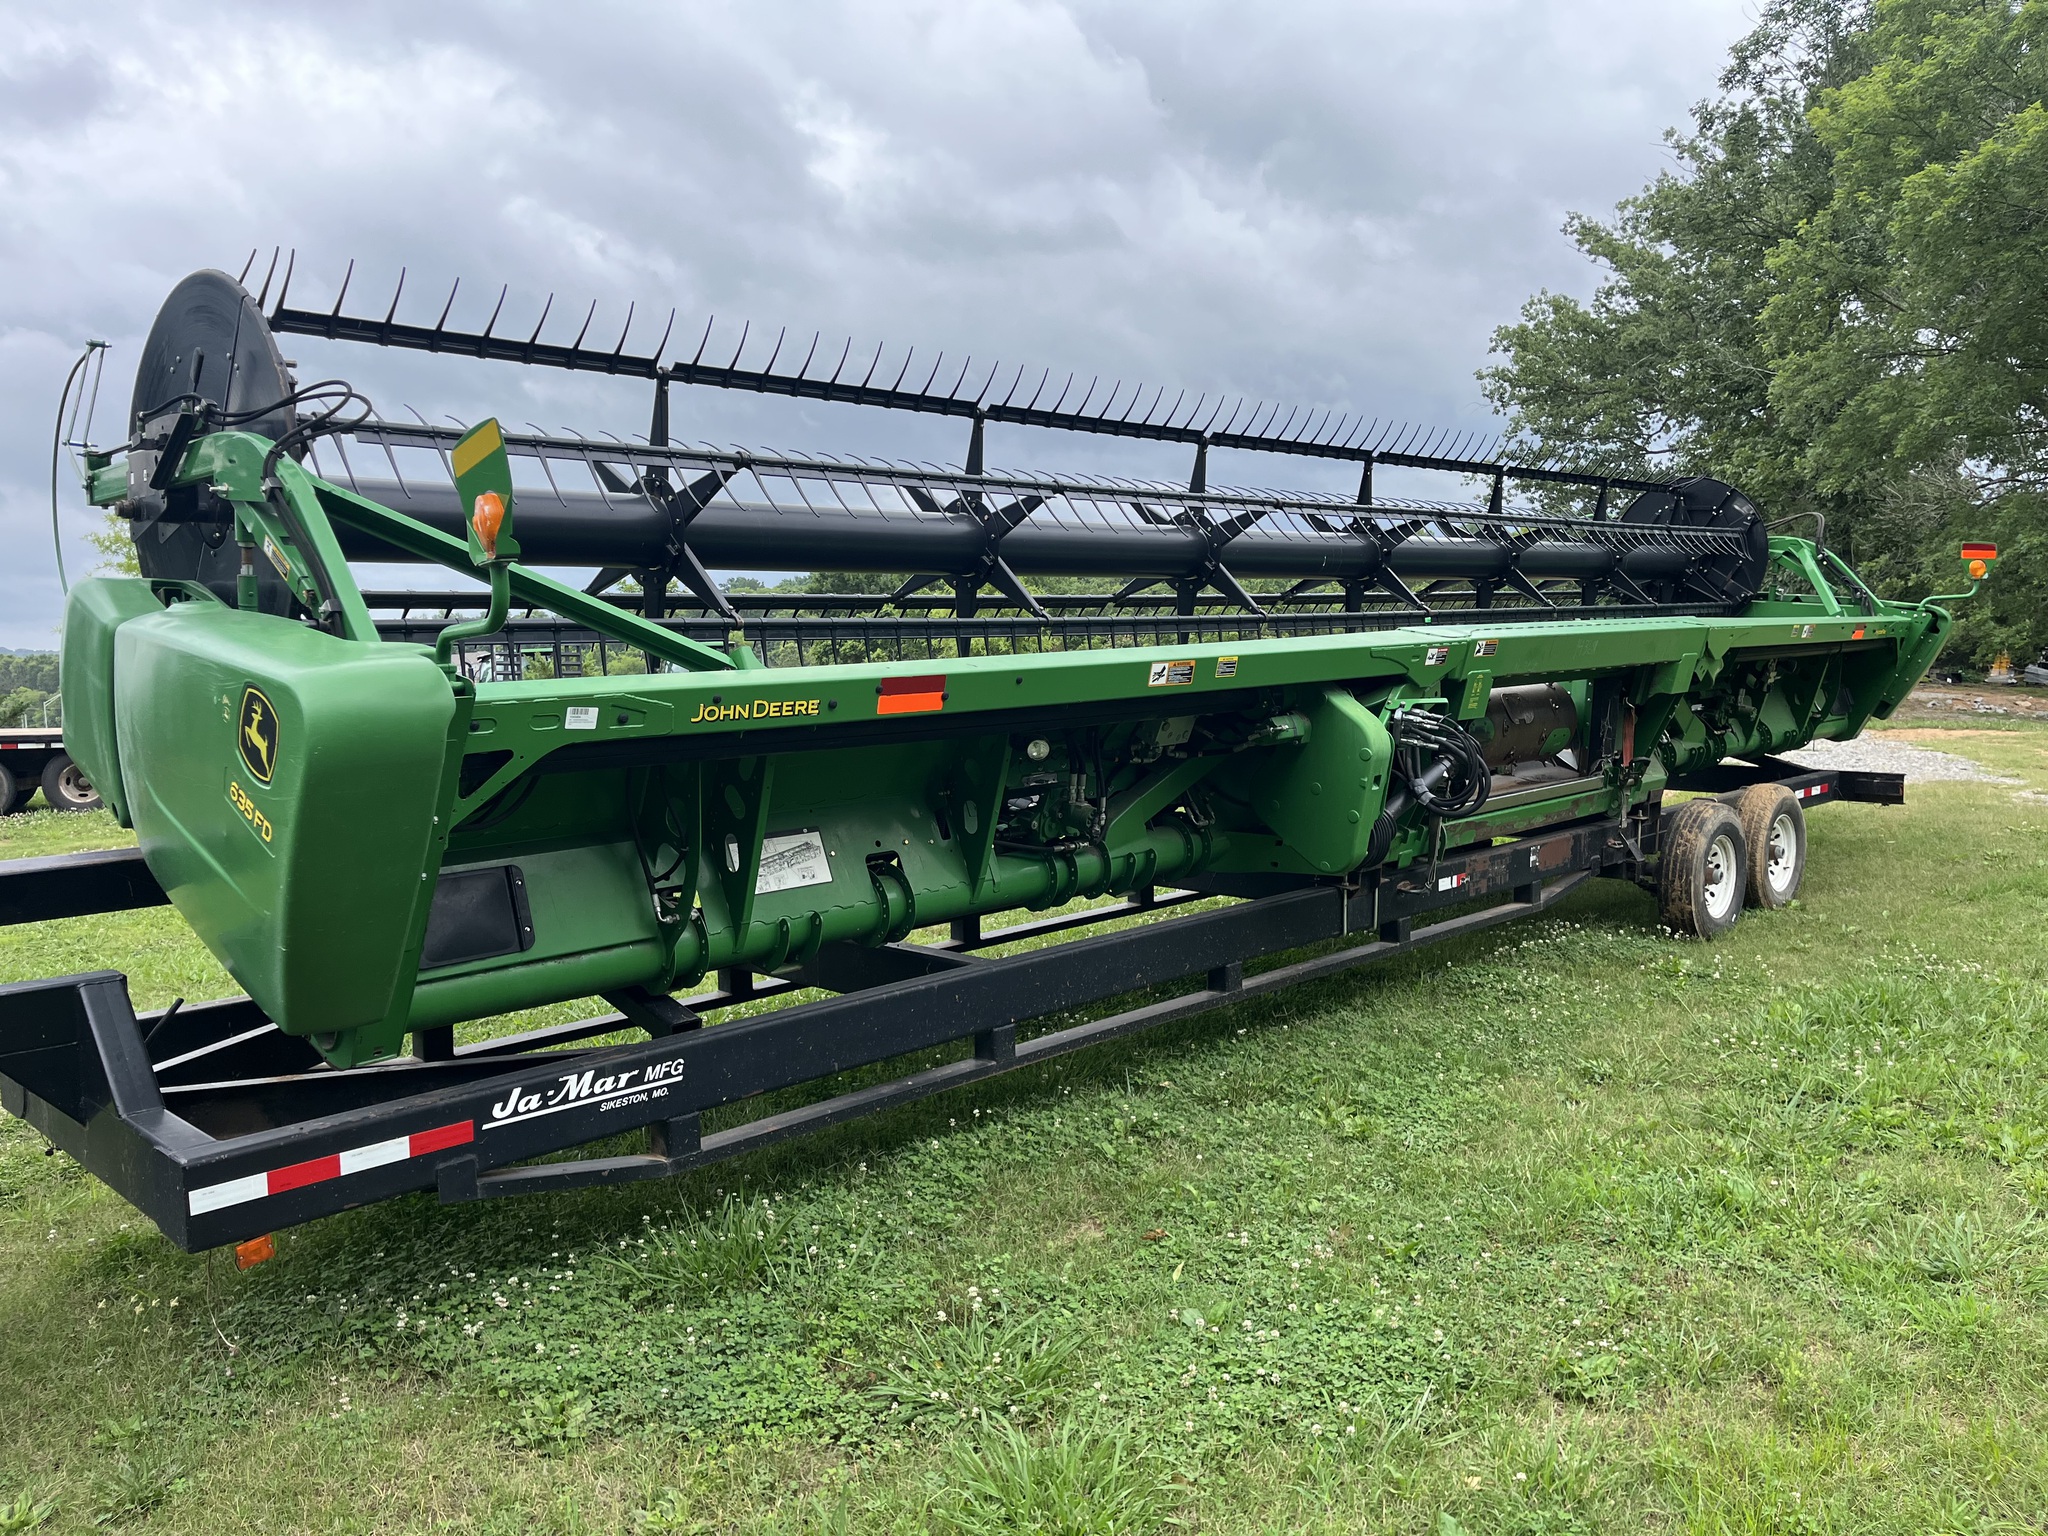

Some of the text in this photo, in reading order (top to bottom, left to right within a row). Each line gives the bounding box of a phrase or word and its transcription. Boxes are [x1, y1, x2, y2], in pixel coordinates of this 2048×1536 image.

[690, 699, 820, 723] JOHN DEERE
[644, 1058, 685, 1083] MFG
[599, 1087, 669, 1113] SIKESTON, MO.
